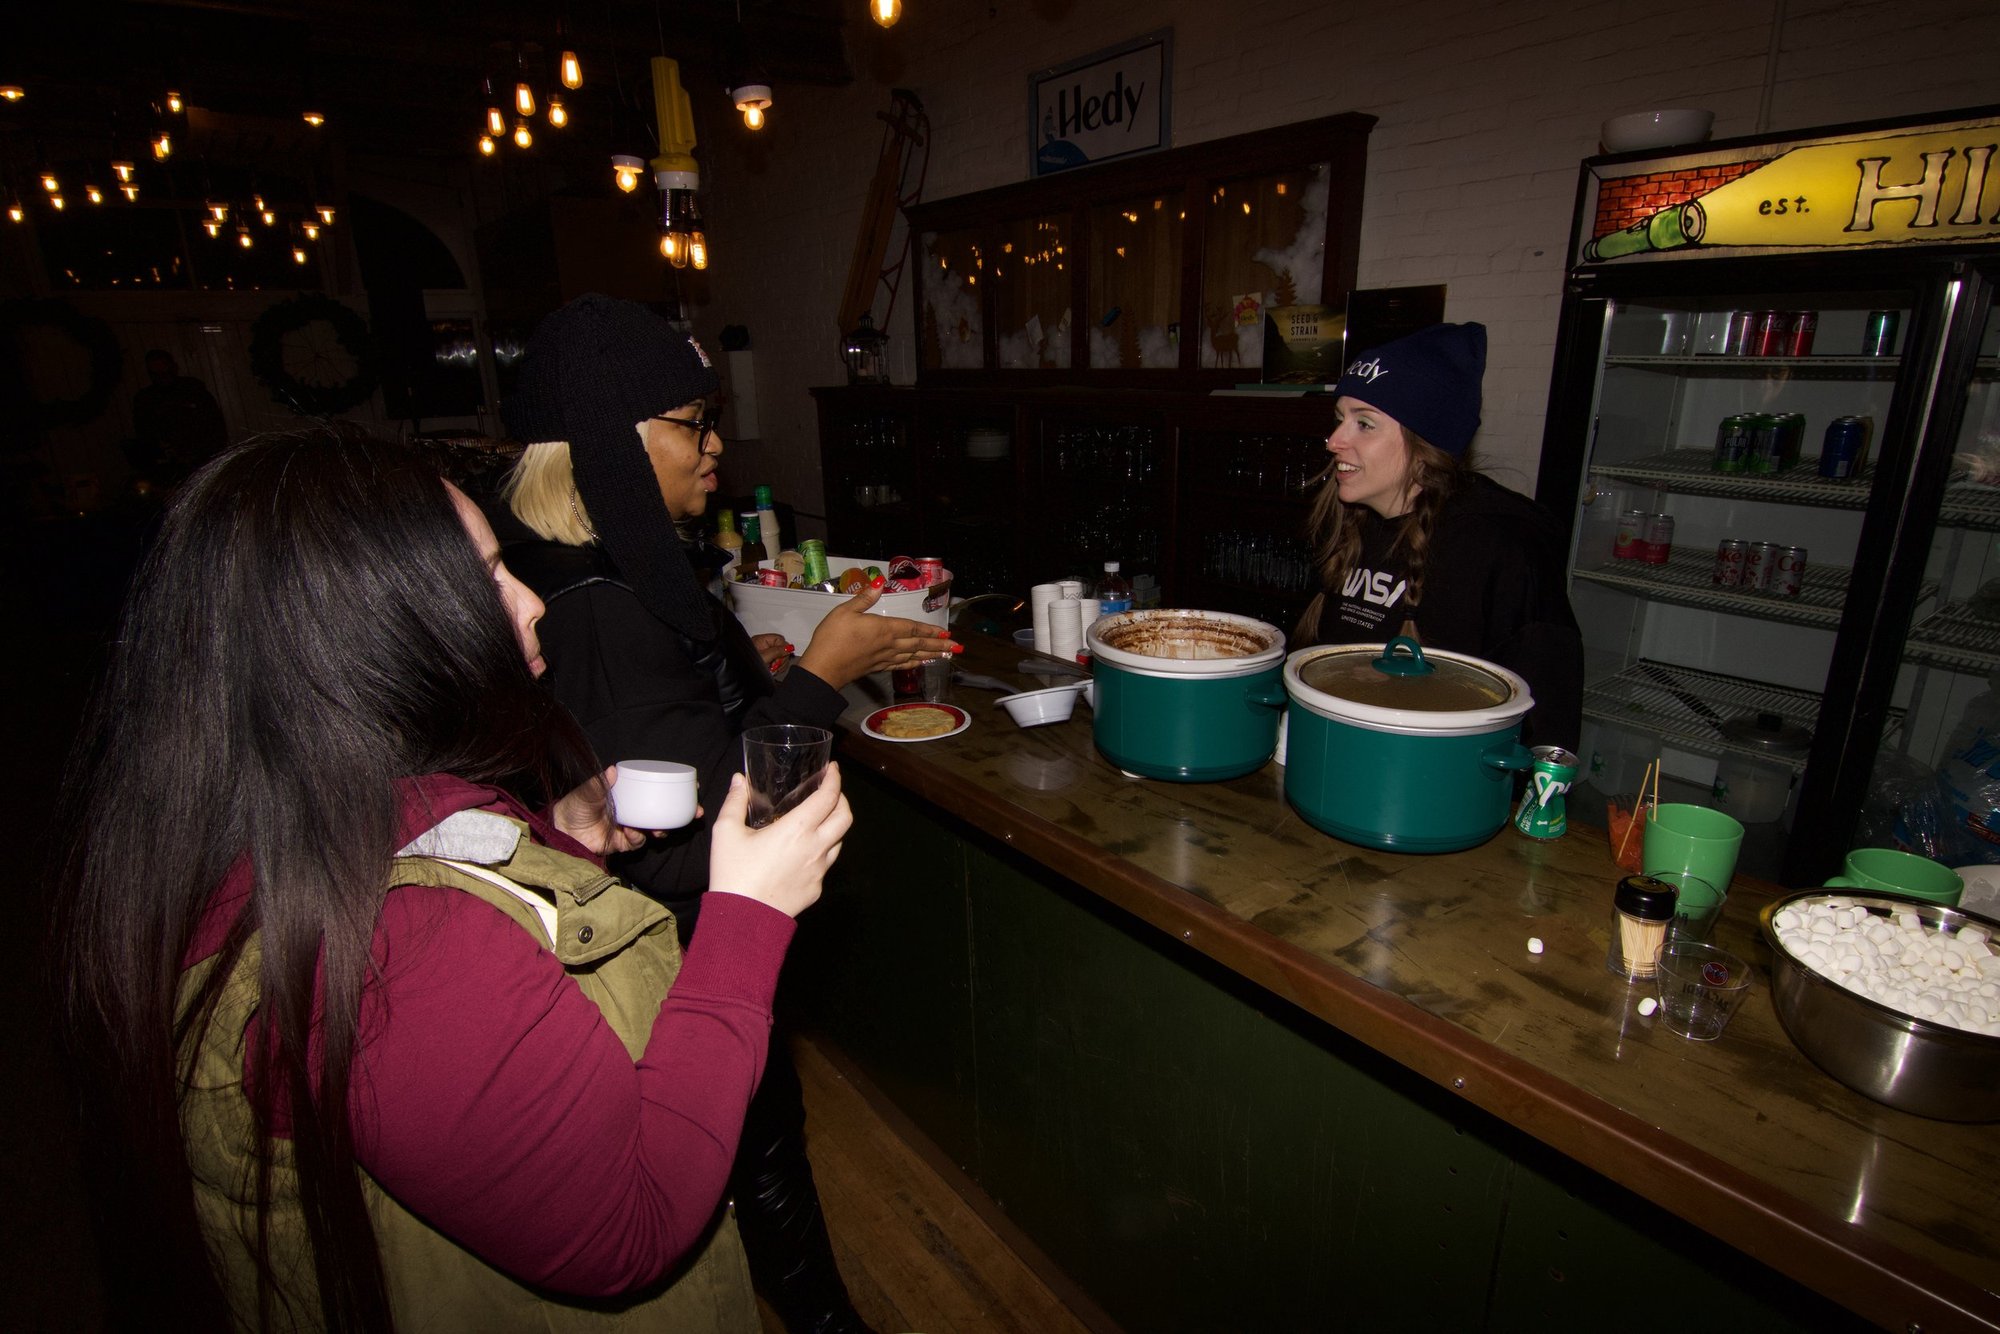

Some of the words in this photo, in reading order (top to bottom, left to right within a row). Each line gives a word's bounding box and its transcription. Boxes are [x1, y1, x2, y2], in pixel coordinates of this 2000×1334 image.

[1059, 71, 1144, 138] Hedy
[1758, 195, 1810, 215] est.
[1843, 144, 2000, 232] HI
[1291, 313, 1311, 324] SEED
[1291, 325, 1318, 336] STRAIN
